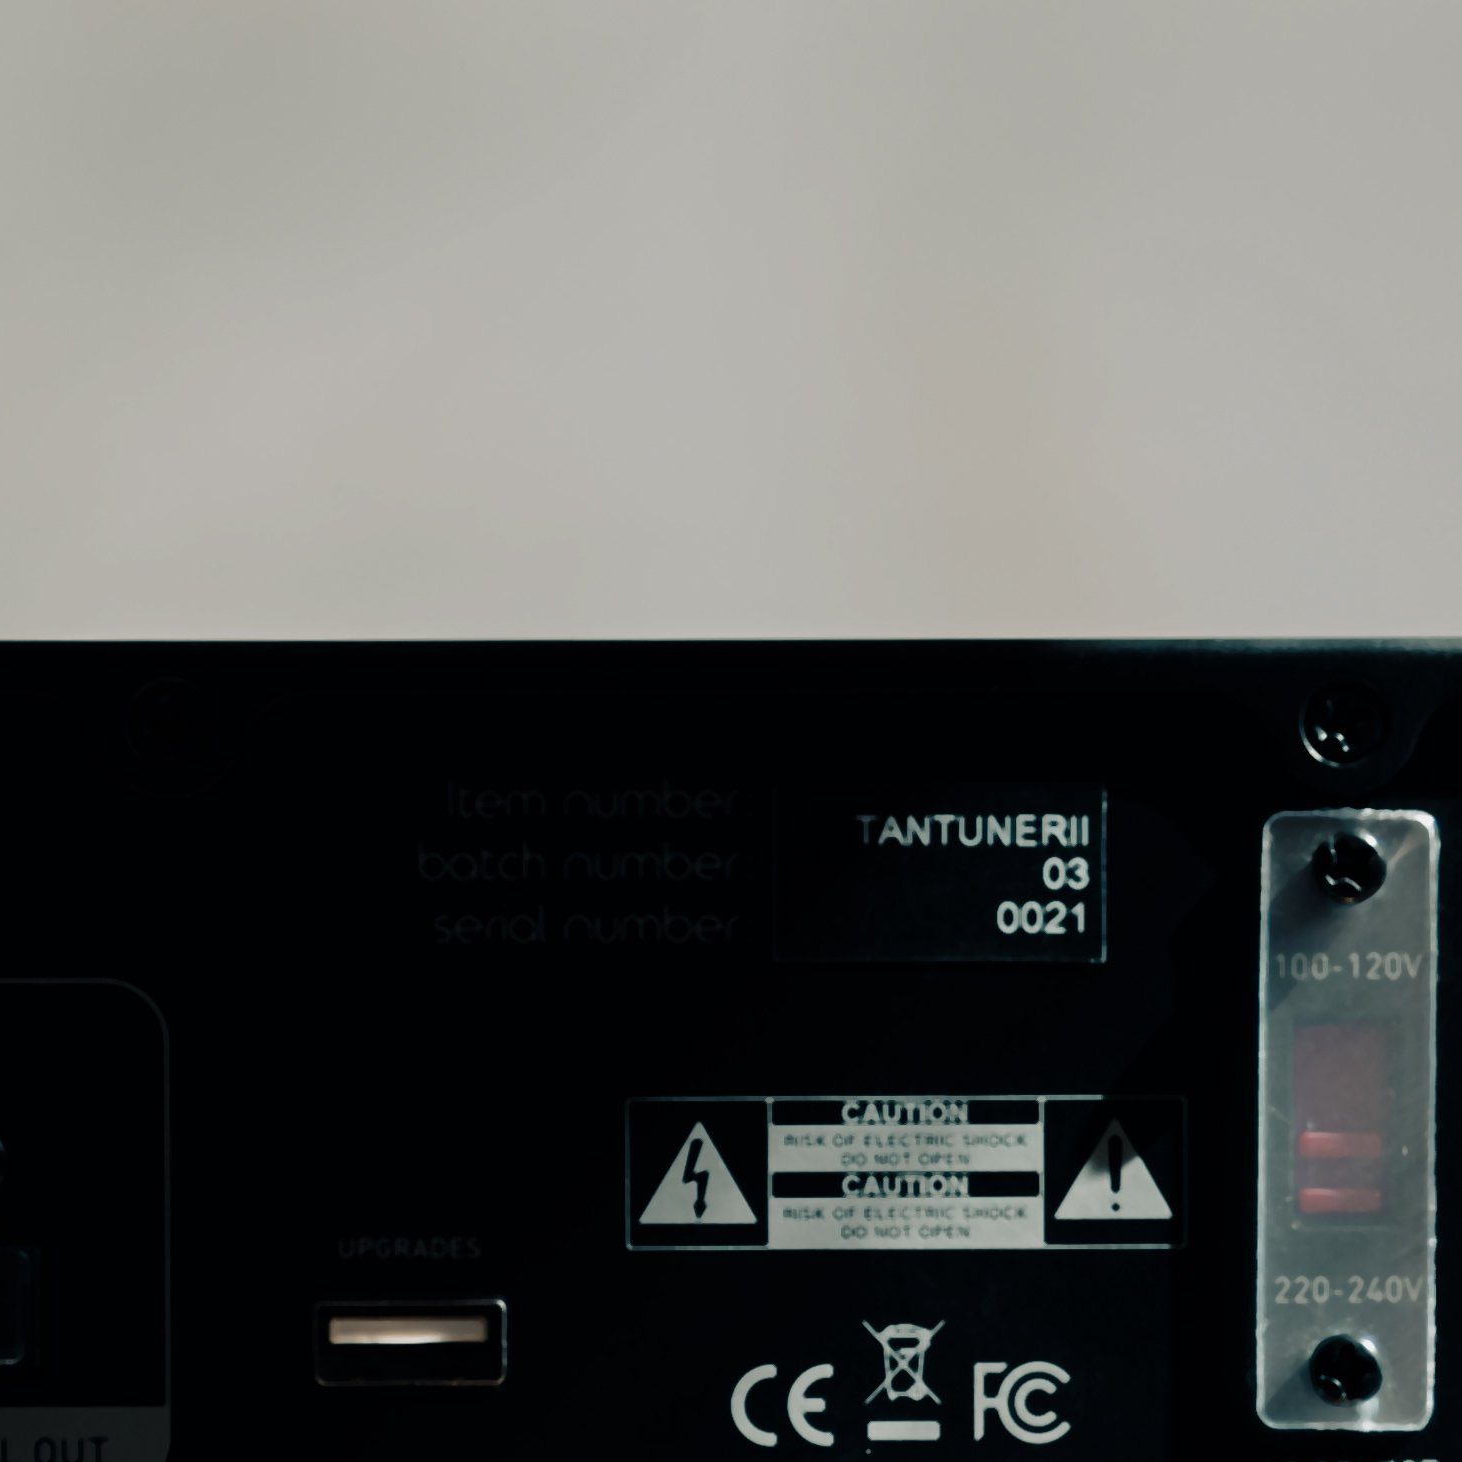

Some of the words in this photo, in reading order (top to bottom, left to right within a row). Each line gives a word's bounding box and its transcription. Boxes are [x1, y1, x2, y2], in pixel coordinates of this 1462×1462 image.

[855, 812, 1091, 847] TANTUNERII
[417, 841, 546, 881] batch
[1042, 856, 1091, 892] 03
[434, 904, 546, 943] serial
[995, 900, 1088, 935] 0021
[1276, 951, 1422, 981] 100-120V
[841, 1101, 969, 1124] CAUTION
[841, 1174, 969, 1197] CAUTION
[338, 1237, 482, 1260] UPGRADES
[1274, 1276, 1423, 1304] 220-240V
[730, 1362, 836, 1448] CE
